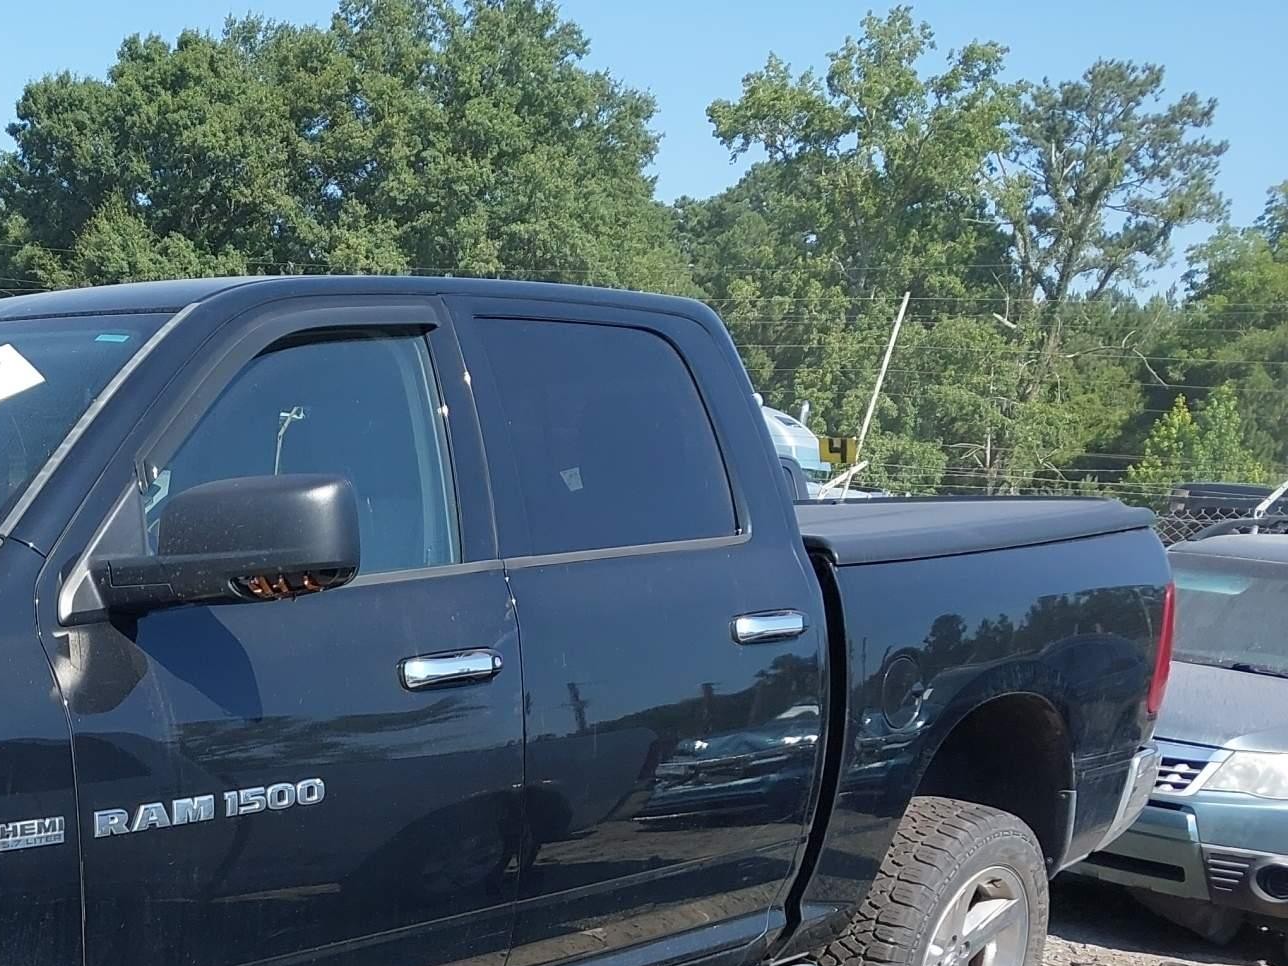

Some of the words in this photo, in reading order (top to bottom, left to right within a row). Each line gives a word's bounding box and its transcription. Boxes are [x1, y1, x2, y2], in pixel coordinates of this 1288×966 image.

[828, 438, 848, 464] 4
[94, 795, 215, 838] RAM
[223, 778, 326, 818] 1500
[0, 817, 65, 840] HEMI
[25, 833, 62, 846] LITER
